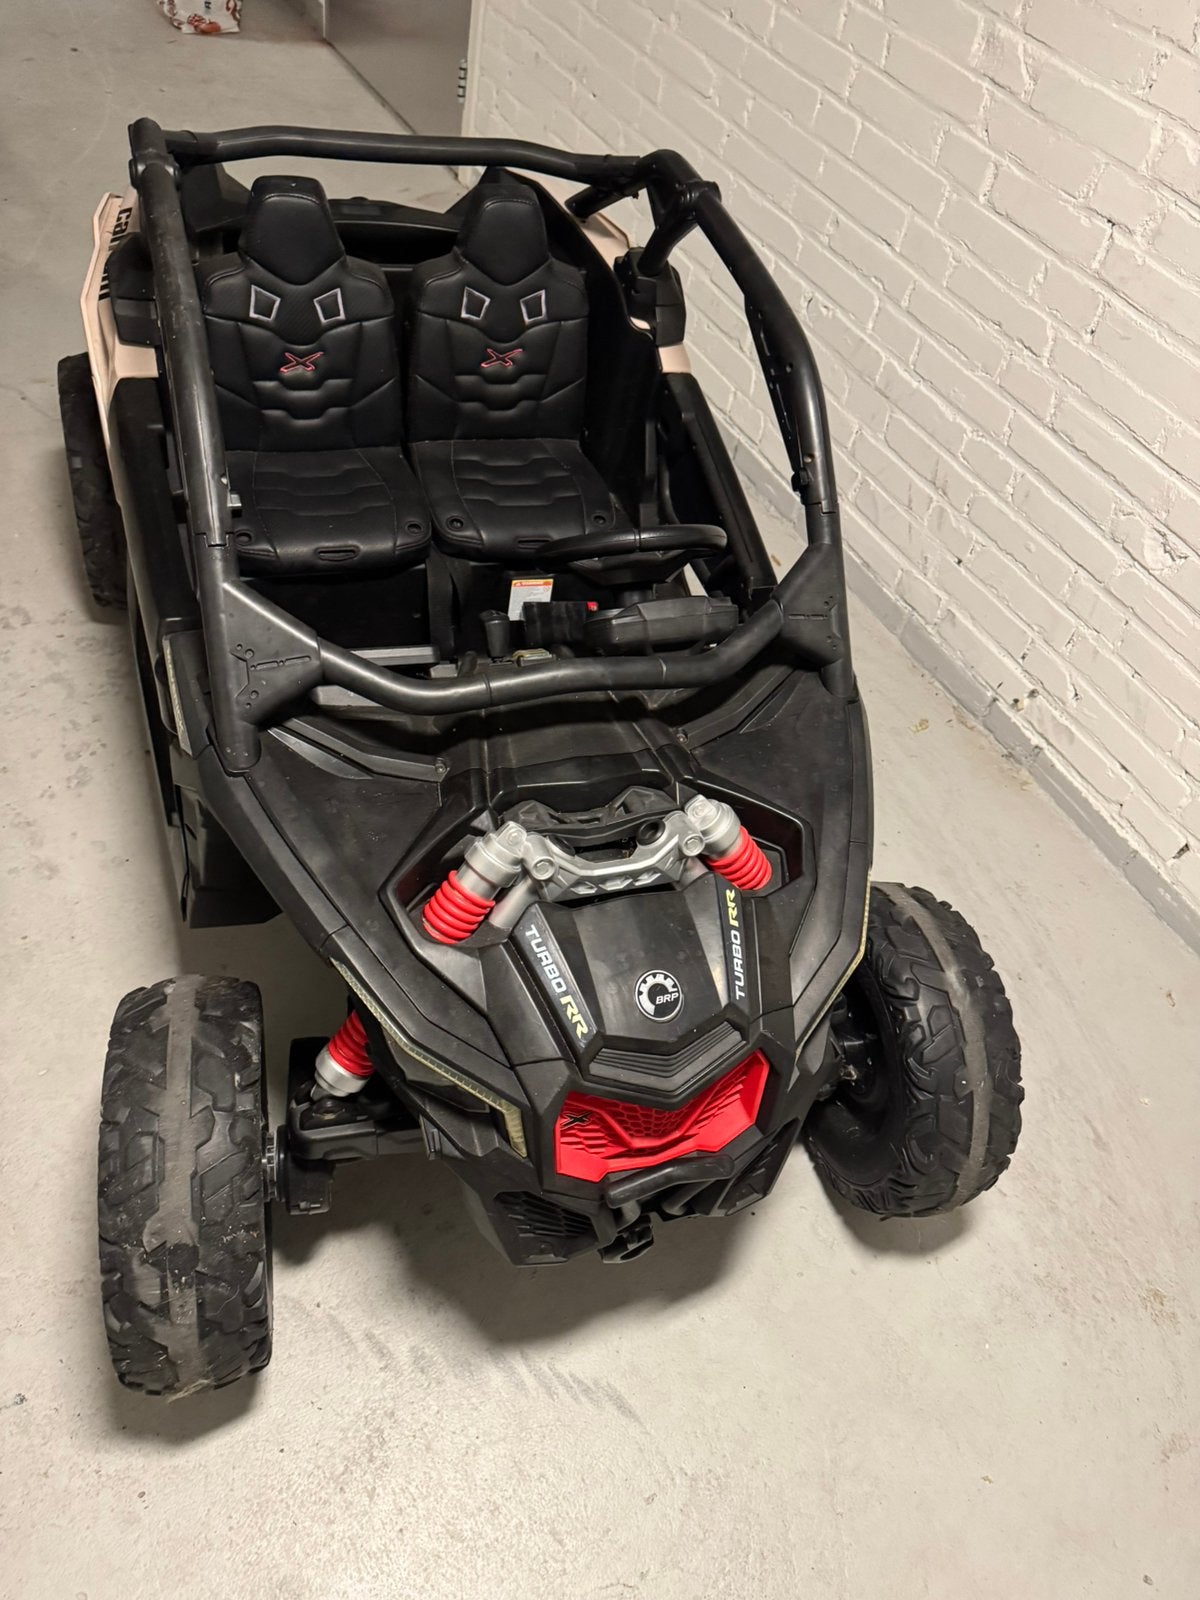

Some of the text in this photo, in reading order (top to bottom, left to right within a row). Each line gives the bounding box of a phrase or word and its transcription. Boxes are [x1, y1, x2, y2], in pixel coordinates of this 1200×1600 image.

[524, 924, 589, 1040] TURBO RR
[655, 992, 680, 1005] BRP
[726, 889, 745, 1000] TURBO RR
